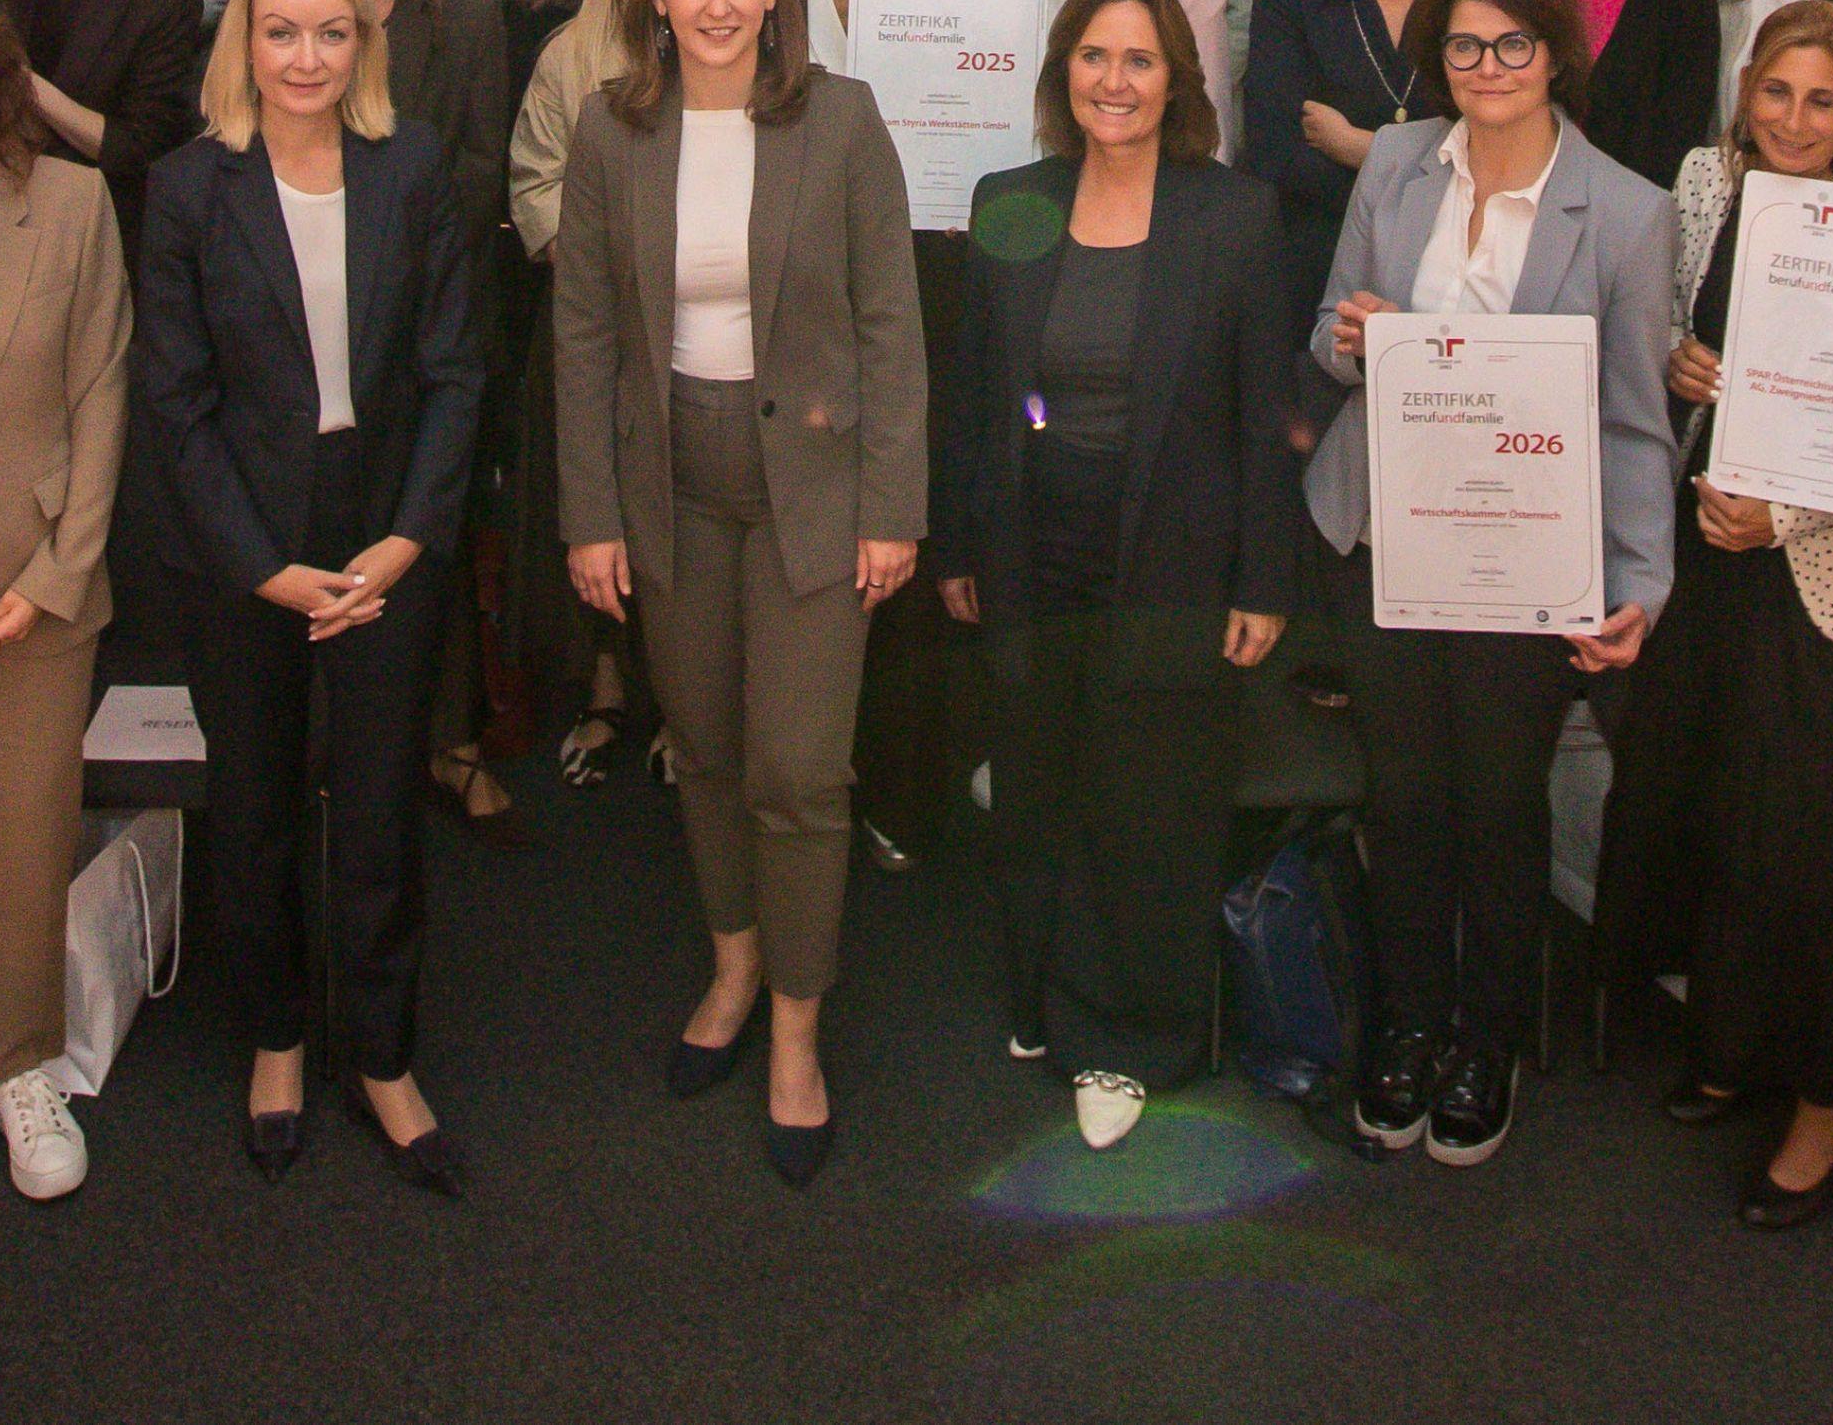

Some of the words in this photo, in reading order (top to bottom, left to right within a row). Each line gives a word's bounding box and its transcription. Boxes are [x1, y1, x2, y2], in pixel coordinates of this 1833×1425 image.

[879, 14, 961, 29] ZERTIFIKAT
[878, 31, 965, 45] berufundfamilie
[956, 52, 1016, 72] 2025
[1402, 393, 1497, 407] ZERTIFIKAT
[1402, 411, 1504, 425] berufundfamilie
[1495, 433, 1564, 455] 2026
[1410, 507, 1508, 520] Wirtschaftskammer
[1510, 508, 1562, 521] Österreich
[142, 719, 195, 729] RESER
